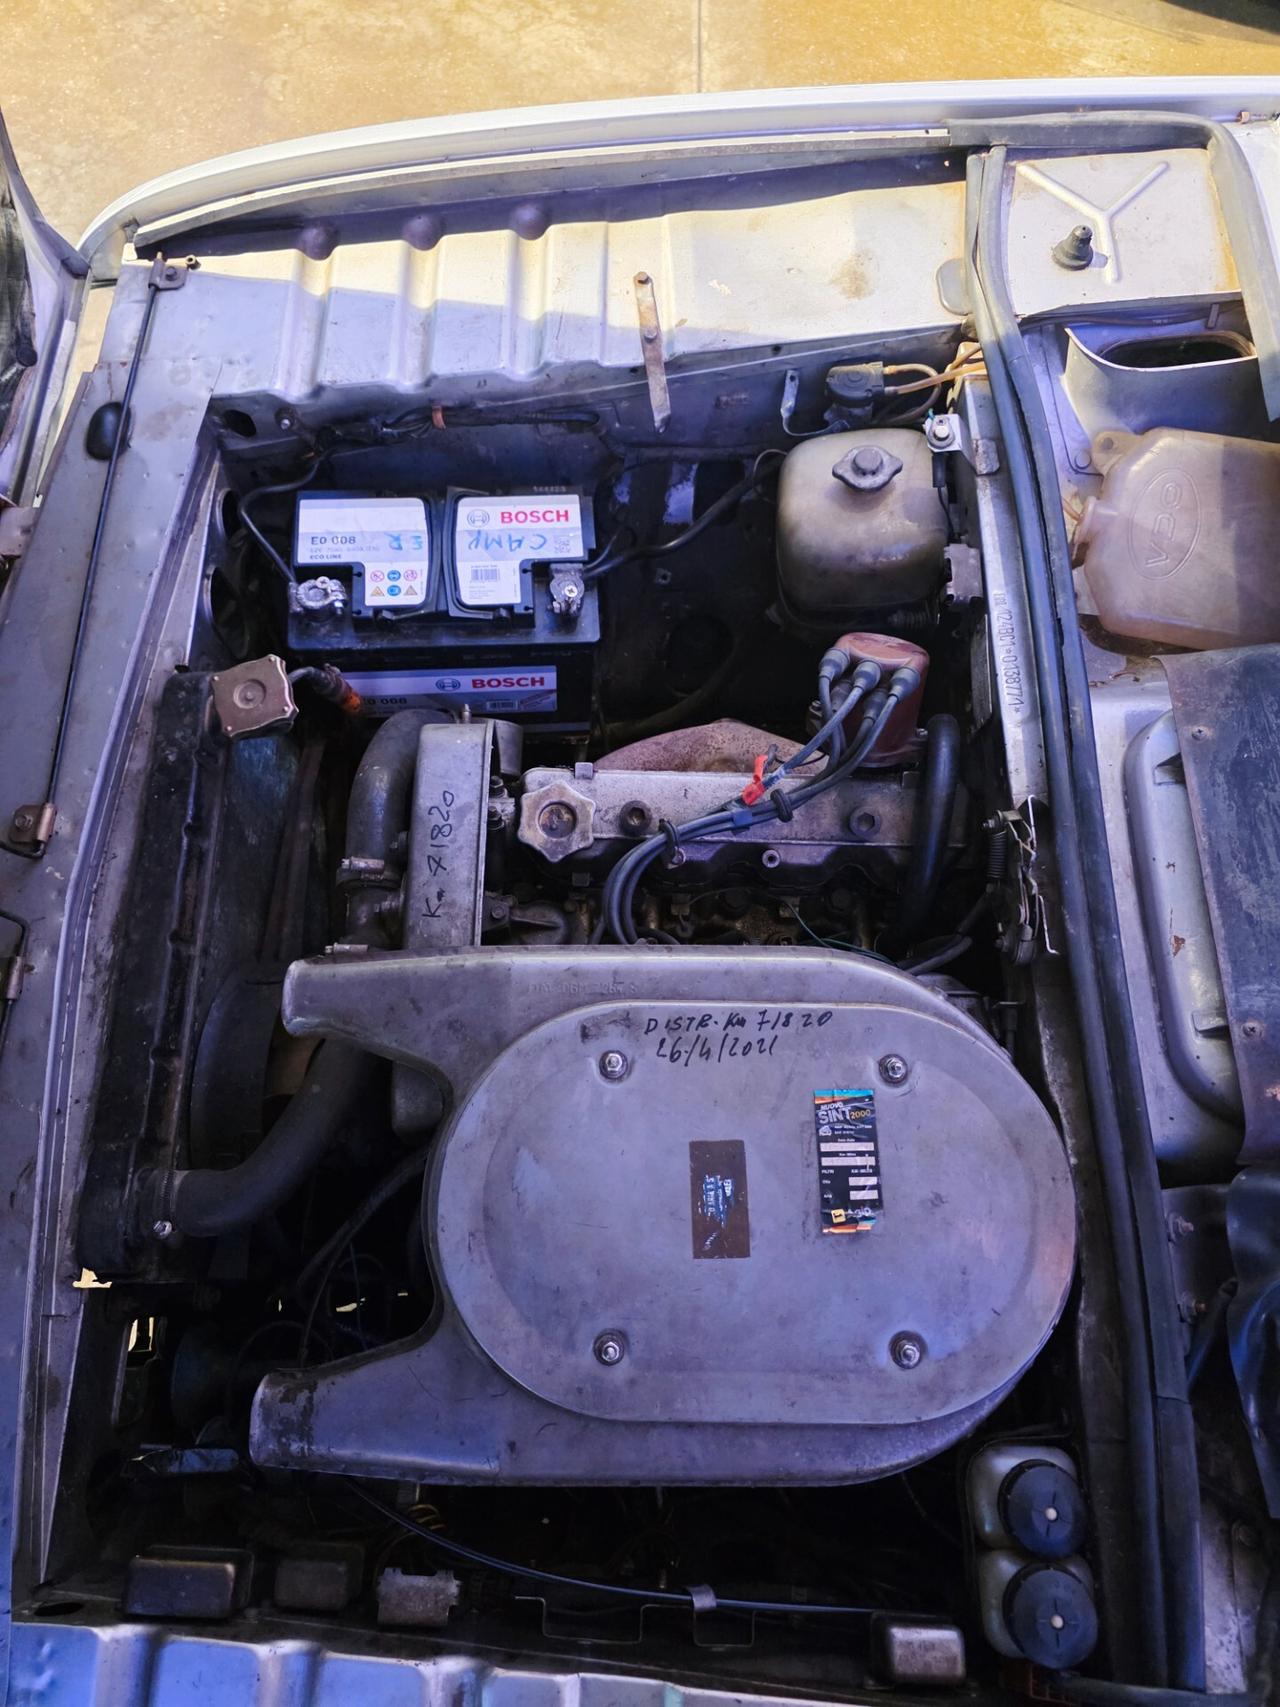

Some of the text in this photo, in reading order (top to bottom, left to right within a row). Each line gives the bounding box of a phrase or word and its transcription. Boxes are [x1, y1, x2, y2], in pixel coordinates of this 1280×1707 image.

[500, 510, 569, 524] BOSCH
[331, 535, 356, 545] 008
[472, 677, 545, 689] BOSCH
[427, 790, 455, 876] 71820
[756, 1009, 833, 1031] 71820
[817, 1106, 871, 1124] SINT 2000
